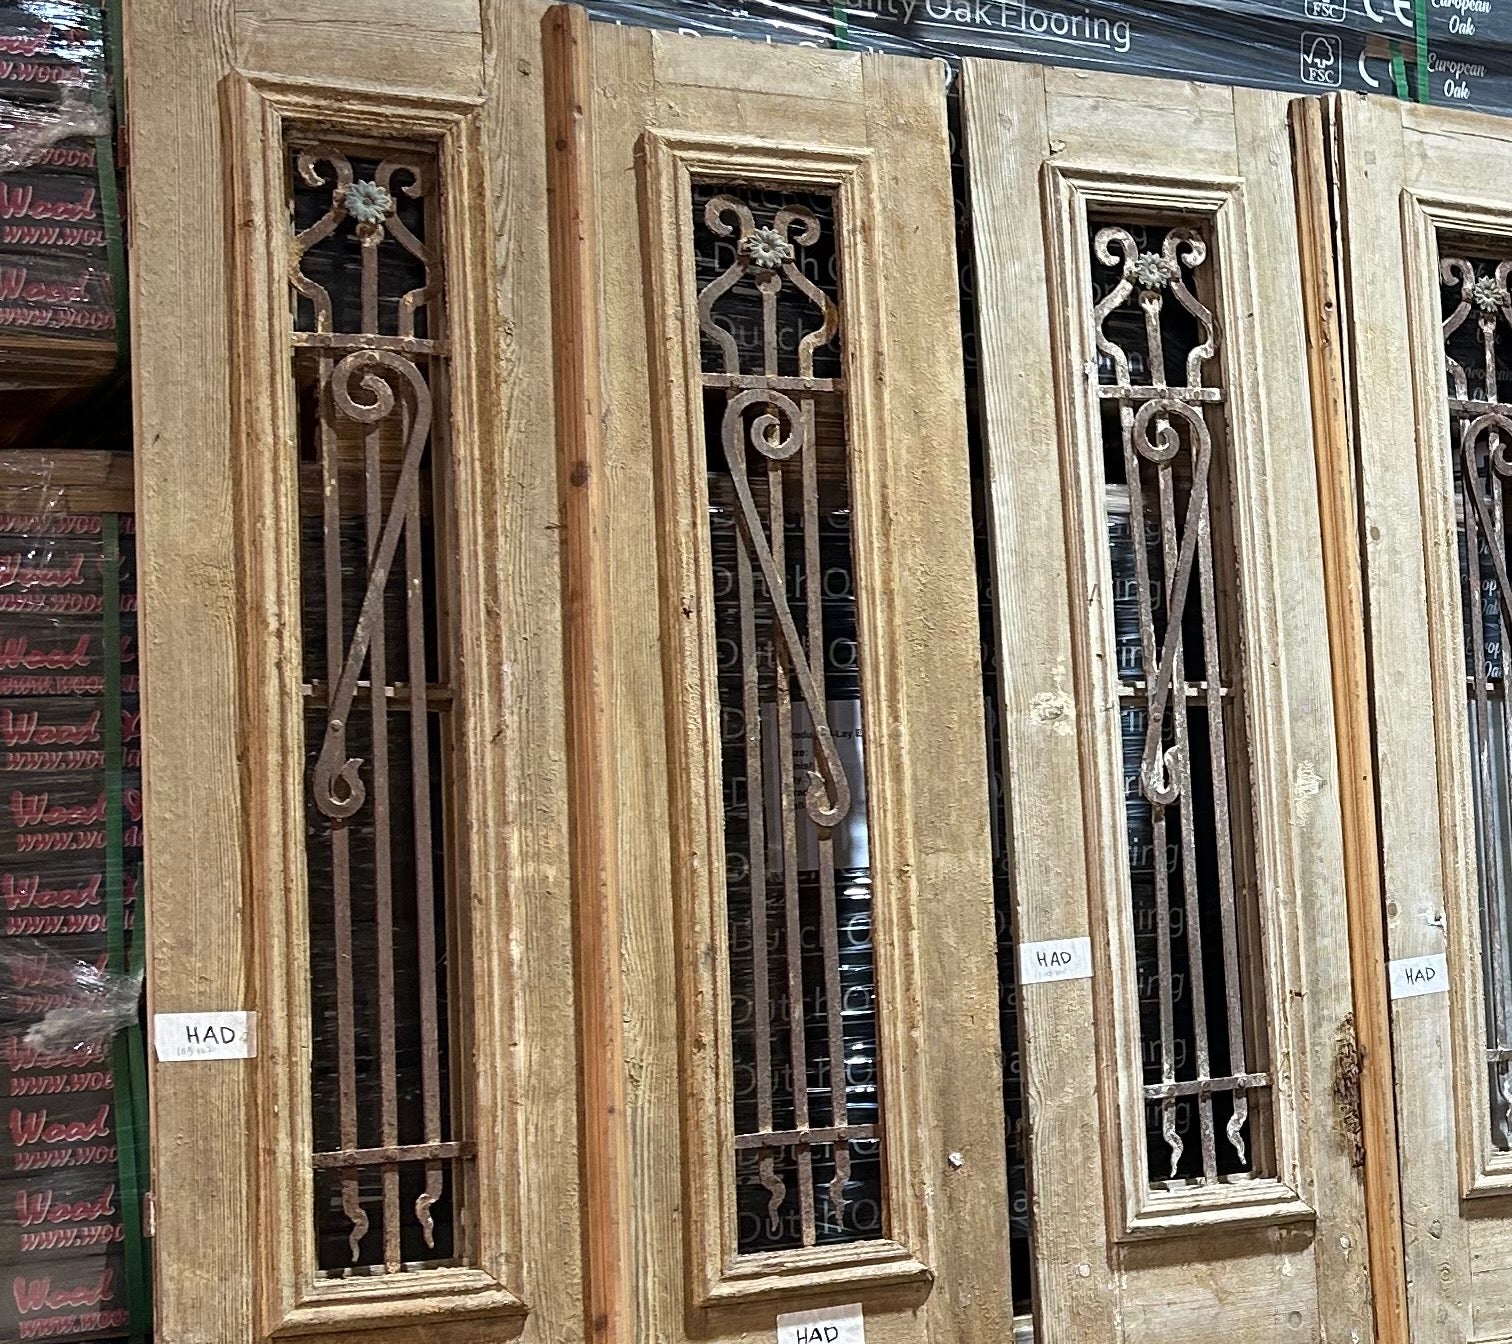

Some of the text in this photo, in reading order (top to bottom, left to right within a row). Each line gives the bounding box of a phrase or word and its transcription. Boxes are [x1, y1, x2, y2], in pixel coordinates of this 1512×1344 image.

[1449, 15, 1477, 36] Oak
[1427, 53, 1487, 78] European
[1443, 80, 1471, 100] Oak
[1036, 951, 1071, 967] HAD
[1405, 967, 1435, 985] HAD
[186, 1026, 235, 1044] HAD
[9, 1104, 109, 1146] Wood
[797, 1326, 838, 1344] HAD
